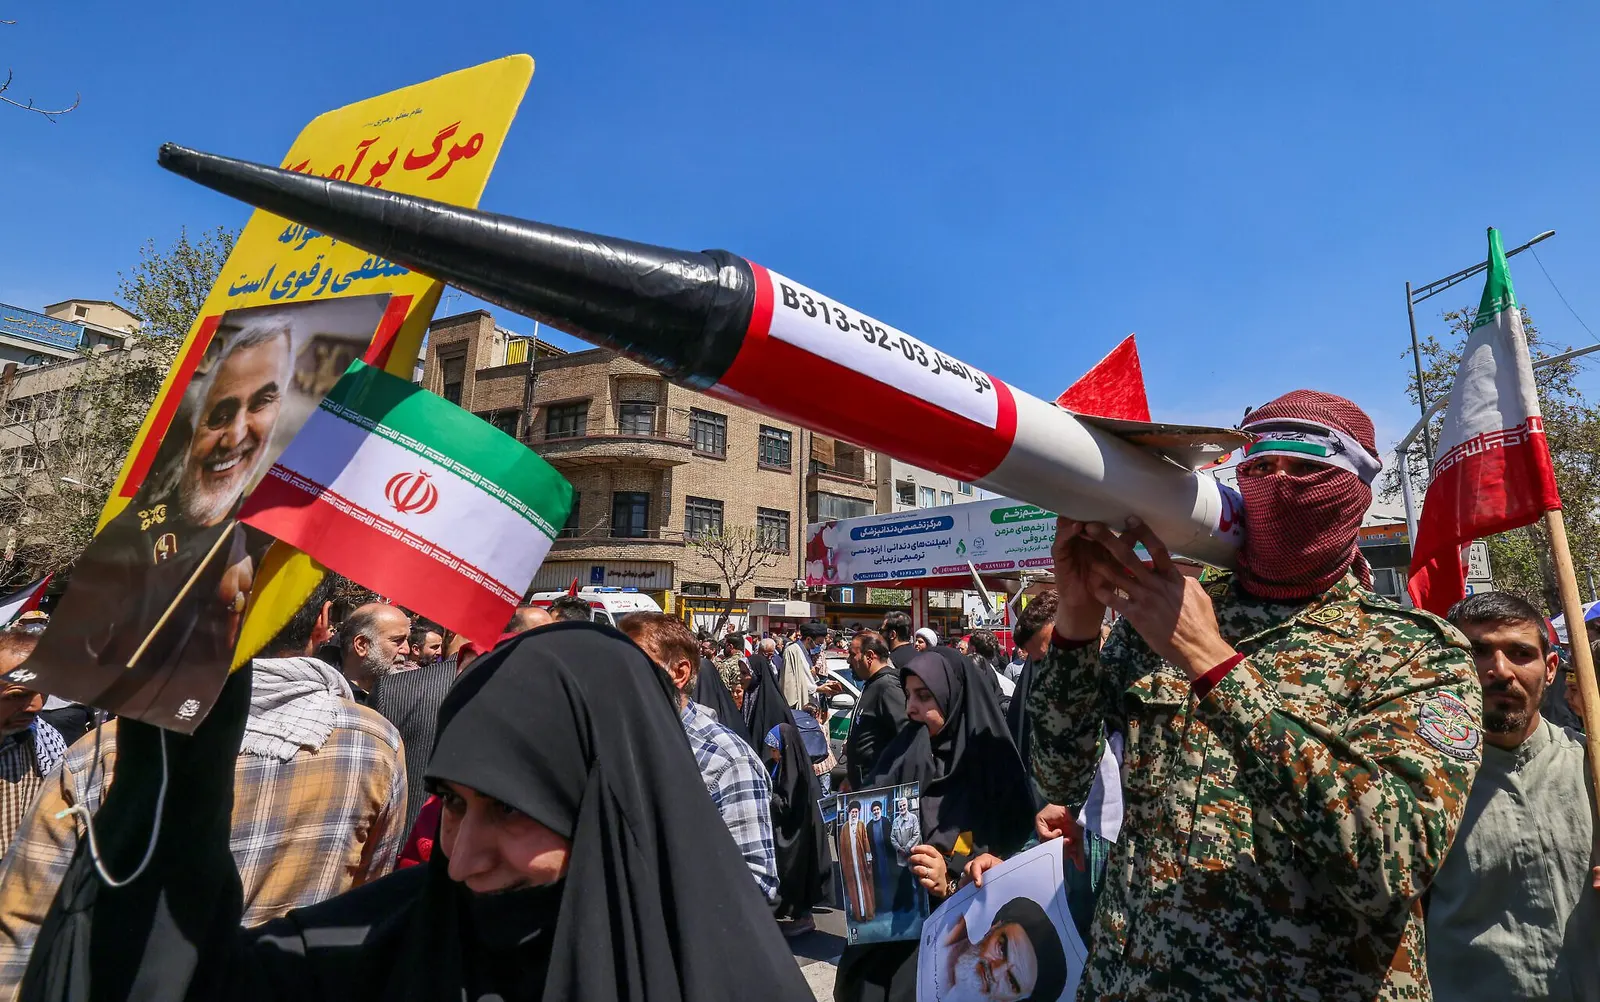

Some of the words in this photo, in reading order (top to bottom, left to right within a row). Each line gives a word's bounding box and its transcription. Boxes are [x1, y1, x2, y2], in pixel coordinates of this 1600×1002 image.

[403, 121, 484, 181] مرگ
[364, 146, 399, 188] بر
[228, 263, 277, 297] است
[269, 254, 325, 300] قوی
[311, 267, 333, 296] و
[780, 282, 929, 367] B313-92-03
[931, 351, 991, 393] ذوالفقار
[1003, 508, 1023, 520] زخم
[897, 520, 926, 533] تخصصی
[925, 519, 942, 530] مرکز
[860, 526, 897, 538] دندانپزشکی
[995, 527, 1015, 537] مزمن
[1023, 533, 1048, 544] عروقی
[851, 545, 882, 556] ارتودنسی
[886, 543, 911, 553] دندانی
[874, 556, 897, 565] زیبایی
[897, 551, 925, 562] ترمیمی
